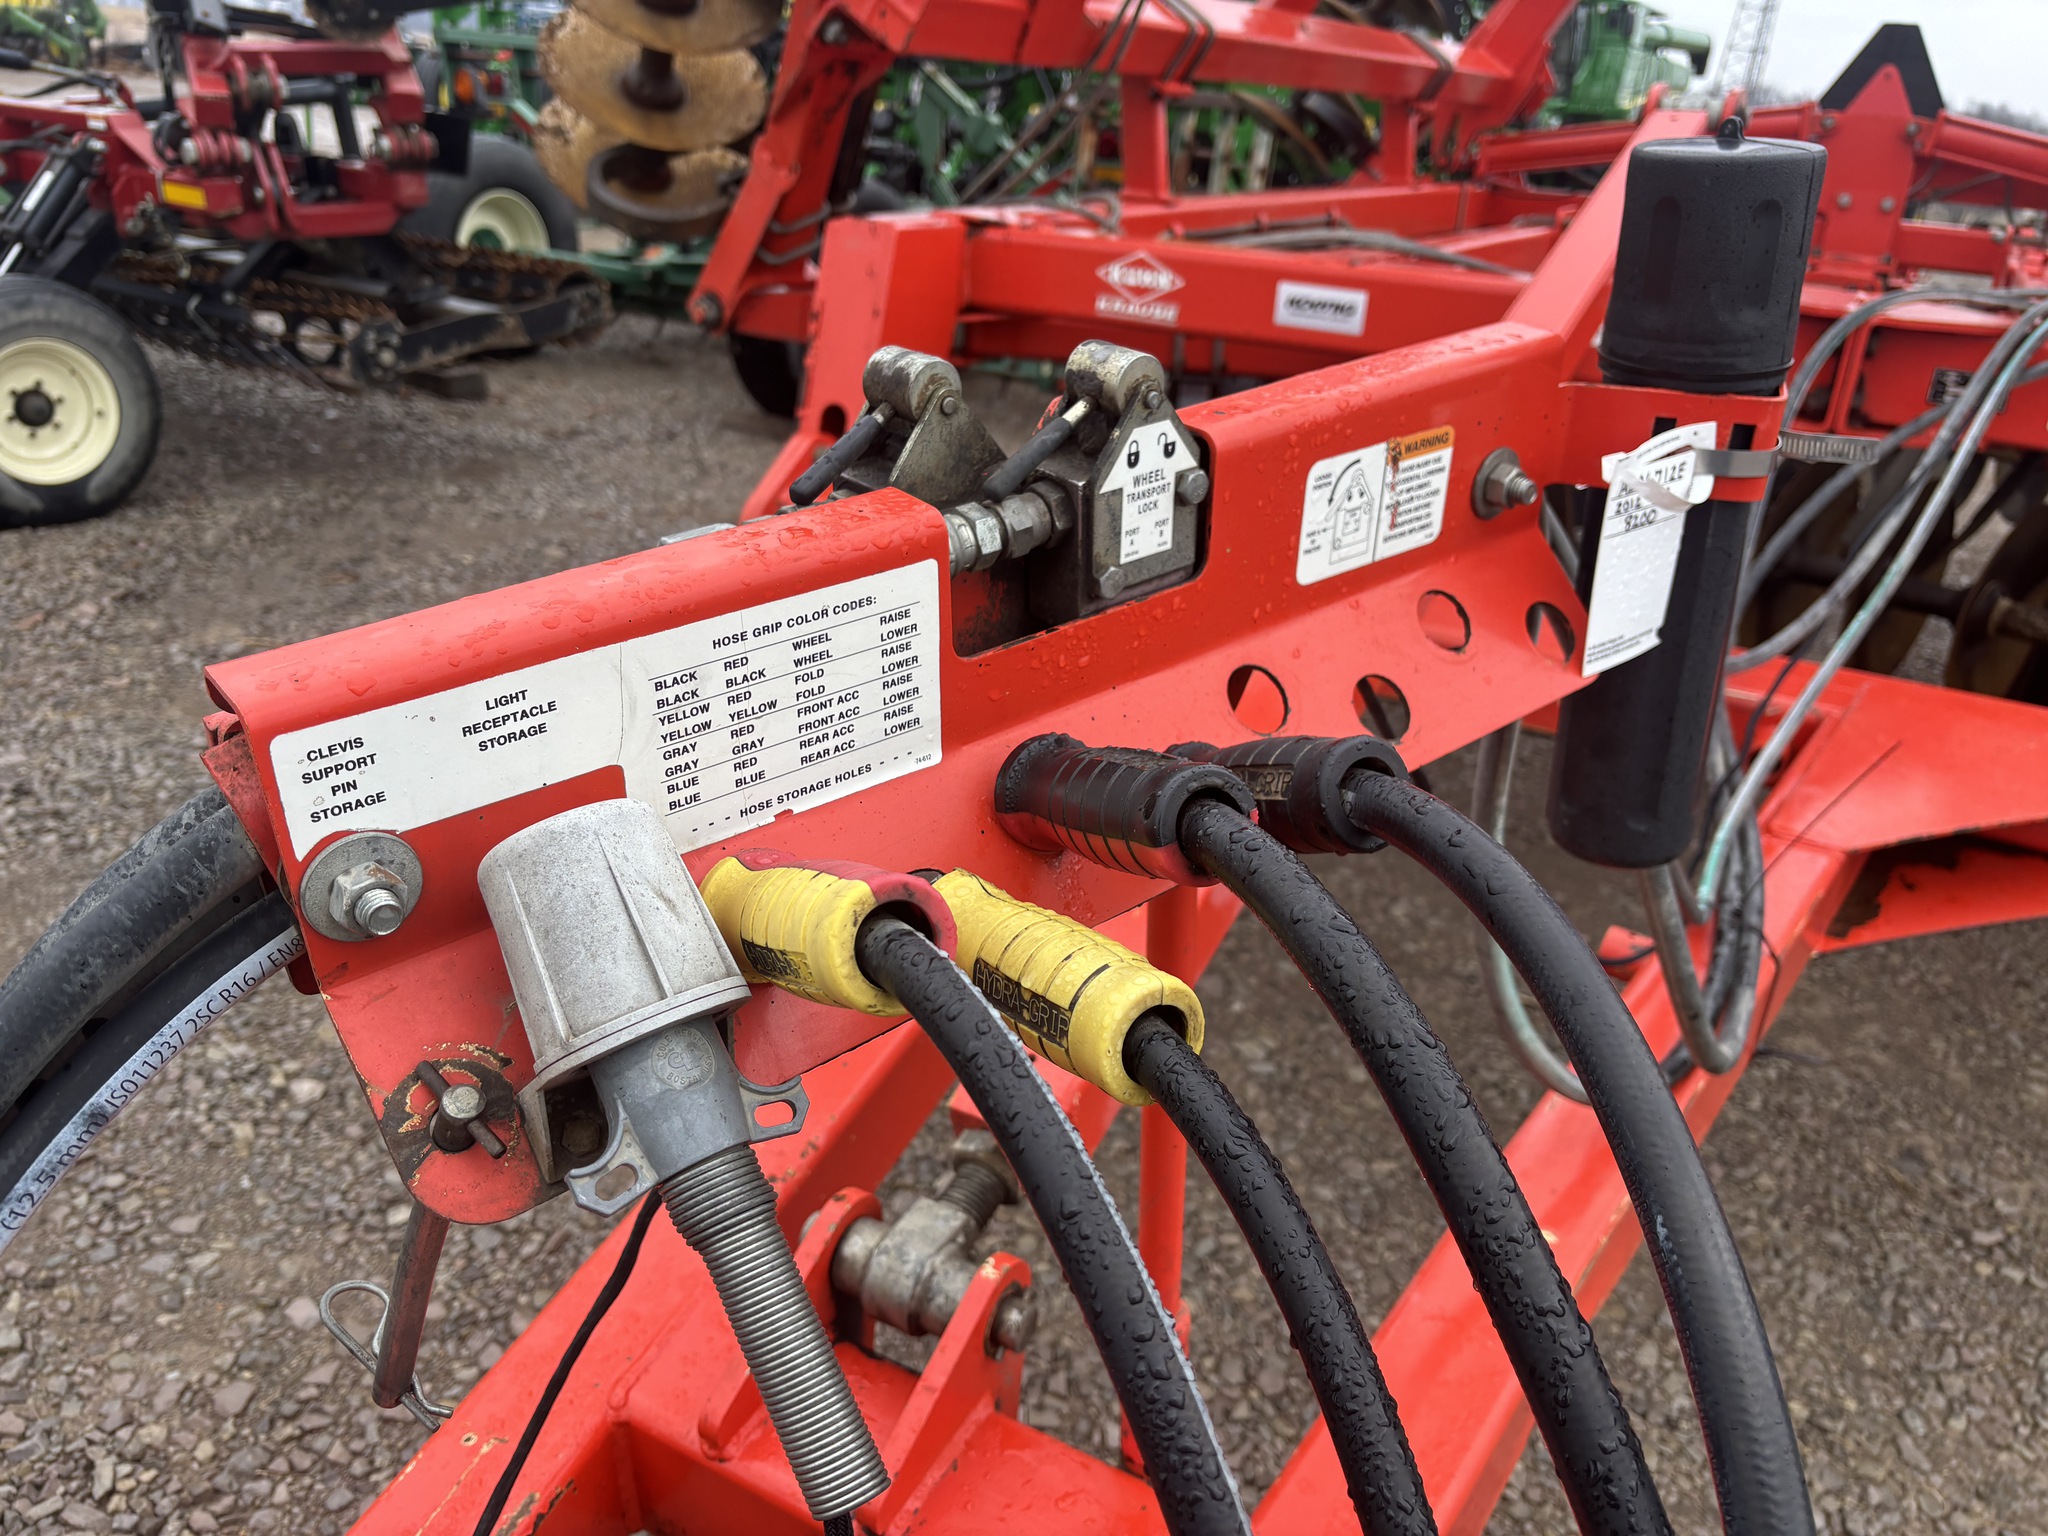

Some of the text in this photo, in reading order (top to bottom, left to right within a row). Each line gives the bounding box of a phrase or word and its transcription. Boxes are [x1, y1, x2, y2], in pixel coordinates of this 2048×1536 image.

[1404, 432, 1450, 454] WARNING
[1126, 483, 1171, 505] TRANSPORT
[1133, 468, 1166, 488] WHEEL
[1138, 500, 1159, 515] LOCK
[1154, 518, 1169, 529] PORT
[1125, 527, 1140, 538] PORT
[712, 596, 877, 650] HOSE GRIP COLOR CODES:
[654, 608, 911, 692] BLACK RED WHEEL RAISE
[656, 623, 918, 710] BLACK BLACK WHEEL LOWER
[485, 689, 529, 711] LIGHT
[658, 641, 912, 727] YELLOW RED FOLD RAISE
[660, 655, 919, 744] YELLOW YELLOW FOLD LOWER
[462, 700, 558, 737] RECEPTACLE
[662, 673, 913, 761] GRAY RED FRONT ACC RAISE
[664, 686, 920, 778] GRAY GRAY FRONT ACC LOWER
[306, 736, 365, 762] CLEVIS
[478, 722, 548, 752] STORAGE
[666, 704, 914, 795] BLUE RED REAR ACC RAISE
[301, 753, 377, 785] SUPPORT
[668, 717, 920, 811] BLUE BLUE REAR ACC LOWER
[331, 779, 358, 797] PIN
[739, 763, 872, 818] HOSE STORAGE HOLES
[310, 790, 387, 823] STORAGE
[975, 963, 1070, 1042] HYDRA-GRIP
[57, 1112, 109, 1168] mm)
[185, 998, 223, 1034] 2SC
[218, 971, 257, 1006] R16
[267, 934, 305, 968] EN8
[656, 1034, 673, 1058] COLE
[666, 1072, 702, 1085] BOSTON
